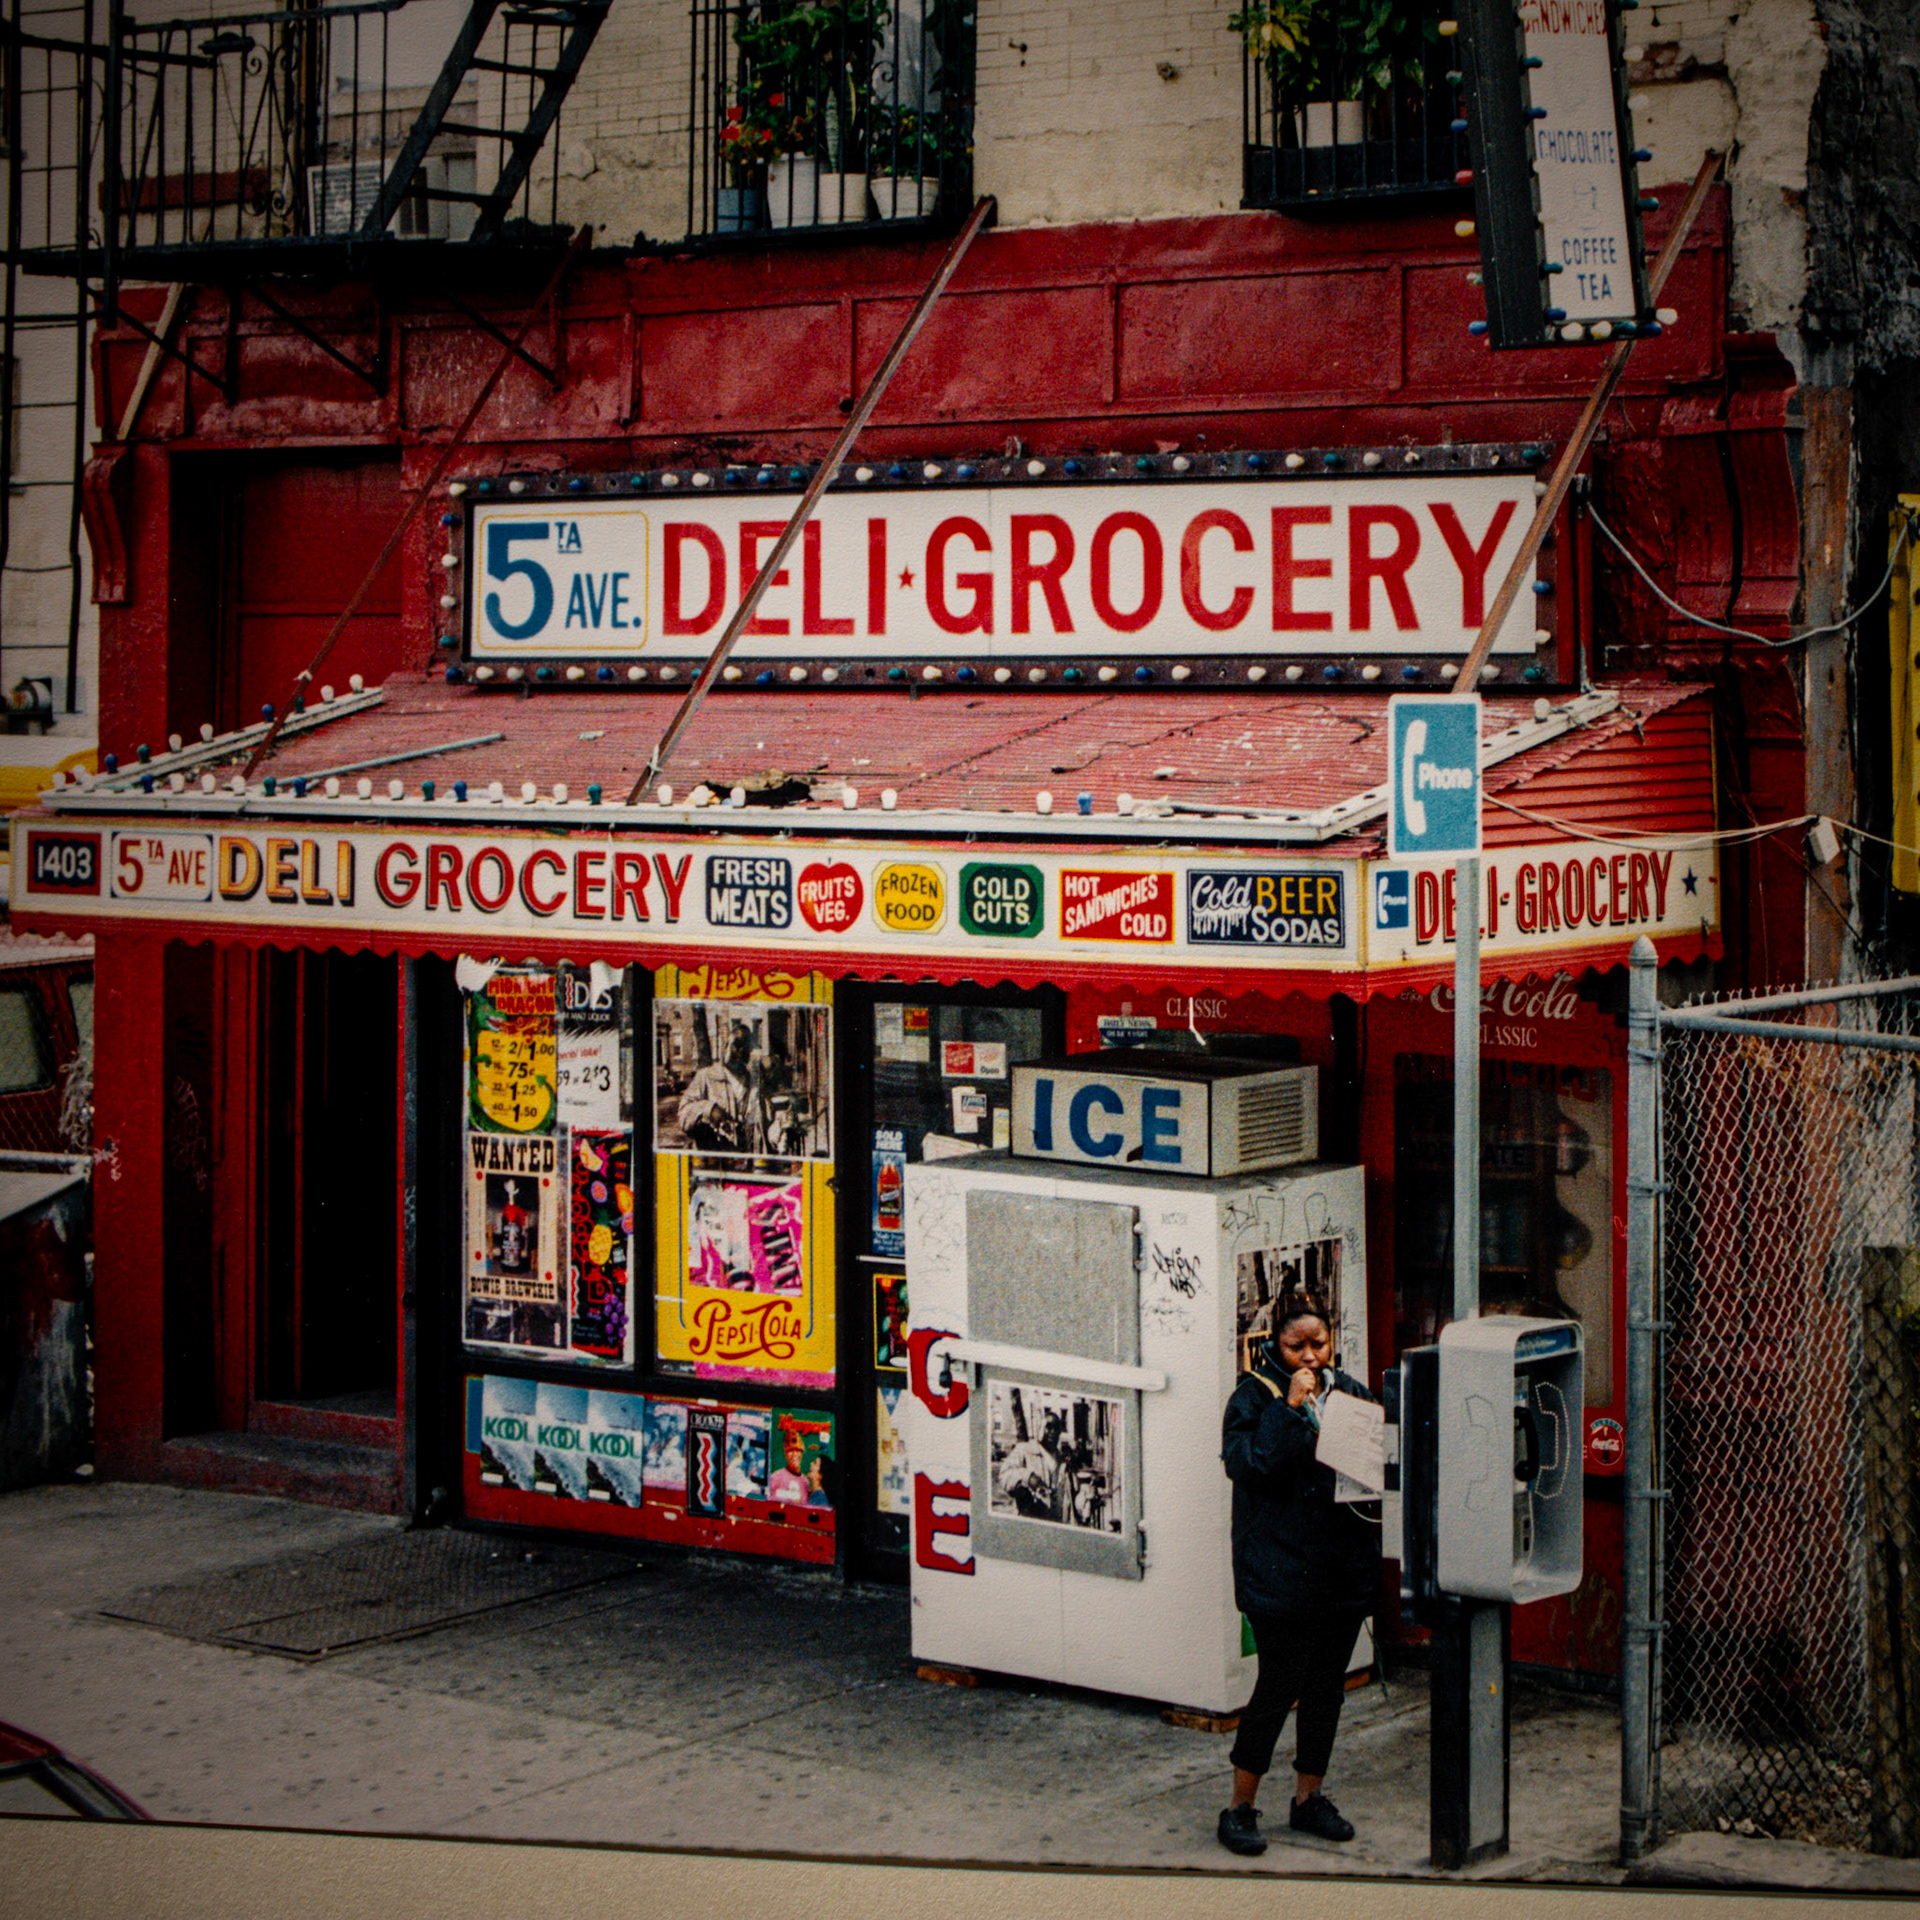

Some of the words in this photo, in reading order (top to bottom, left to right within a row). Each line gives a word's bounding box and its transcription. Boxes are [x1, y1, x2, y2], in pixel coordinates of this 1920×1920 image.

[1538, 129, 1616, 165] CHOCOLATE
[1562, 237, 1617, 266] COFFEE
[1577, 274, 1612, 301] TEA
[565, 572, 642, 630] AVE.
[662, 517, 887, 636] DELI
[925, 500, 1519, 636] GROCERY
[1417, 762, 1474, 790] Phone
[37, 844, 93, 879] 1403
[712, 858, 786, 887] FRESH
[168, 849, 206, 886] AVE
[217, 836, 356, 907] DELI
[375, 842, 694, 923] GROCERY
[800, 875, 856, 904] FRUITS
[880, 872, 939, 900] FROZEN
[972, 875, 1031, 901] COLD
[1064, 875, 1101, 897] HOT
[1190, 874, 1254, 909] Cold
[1255, 876, 1338, 916] BEER
[709, 888, 789, 926] MEATS
[885, 902, 936, 922] FOOD
[1064, 874, 1159, 935] SANDWICHES
[1415, 866, 1499, 946] DEI
[1516, 850, 1673, 934] GROCERY
[1119, 912, 1168, 938] COLD
[1251, 905, 1340, 945] SODAS
[496, 994, 556, 1015] DRAGON
[1479, 1024, 1538, 1048] LASSIC
[1033, 1078, 1182, 1164] ICE
[471, 1136, 555, 1173] WANTED
[484, 1415, 535, 1444] KOOL
[537, 1424, 585, 1452] KOOL
[589, 1432, 640, 1460] KOOL
